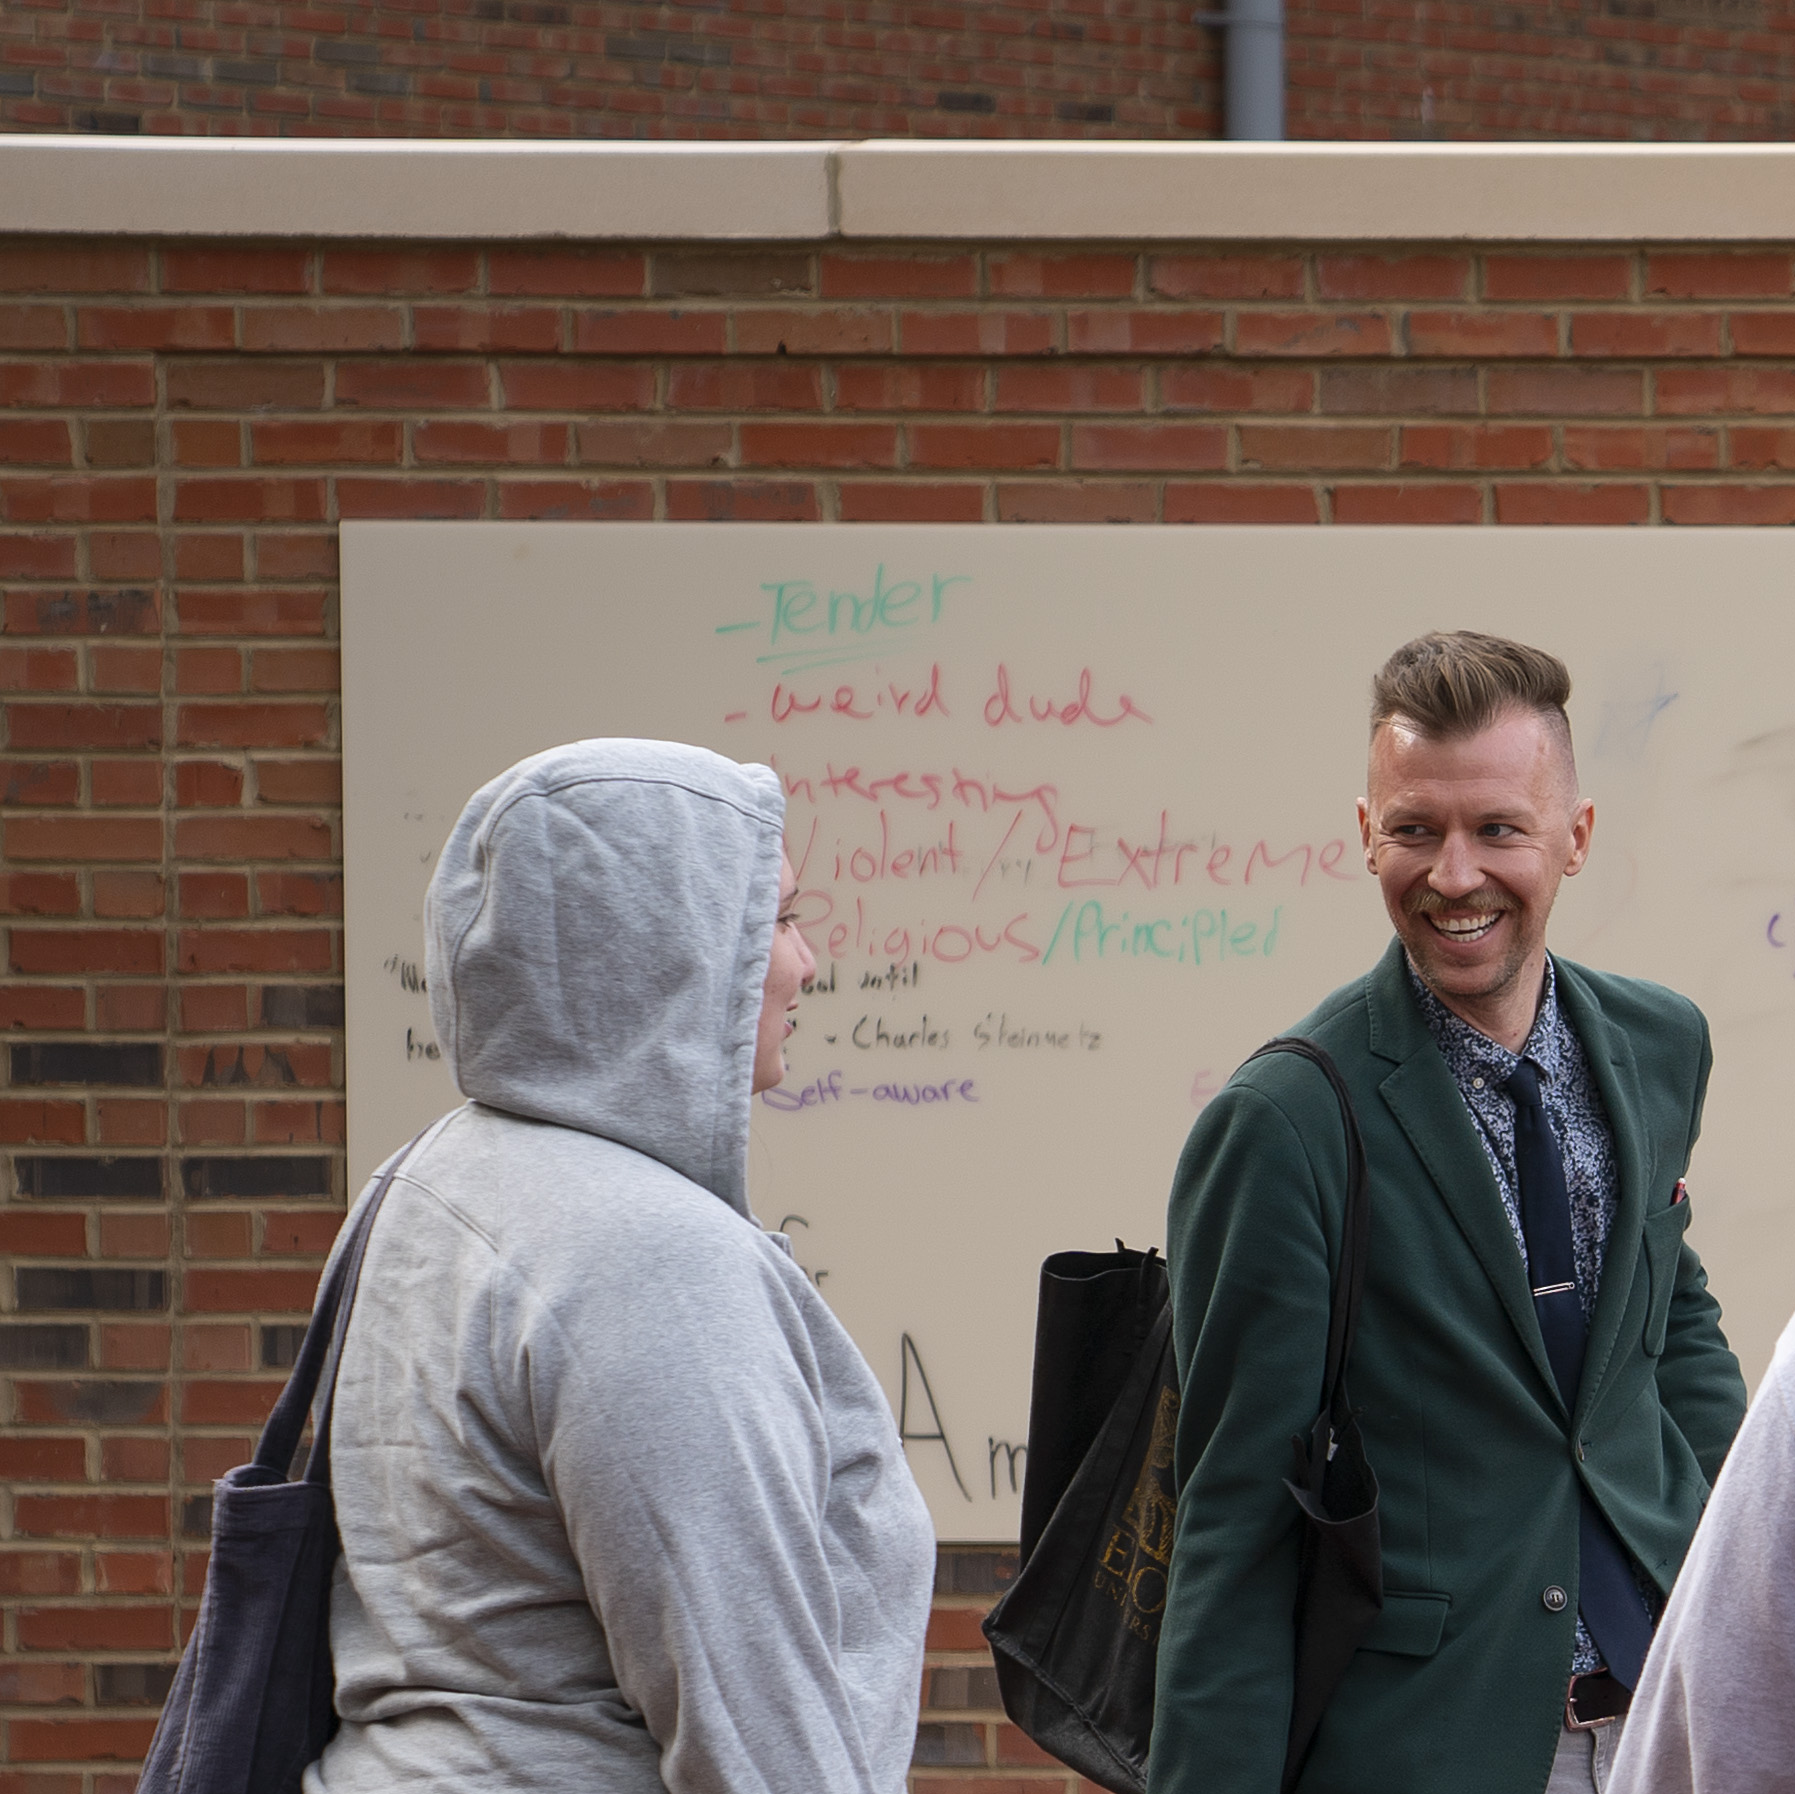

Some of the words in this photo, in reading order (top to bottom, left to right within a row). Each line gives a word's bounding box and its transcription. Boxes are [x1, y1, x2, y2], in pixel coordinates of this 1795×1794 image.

[771, 661, 950, 724] weird
[983, 661, 1154, 727] dude
[770, 754, 1058, 855] nteresting
[851, 1012, 951, 1050] Charles
